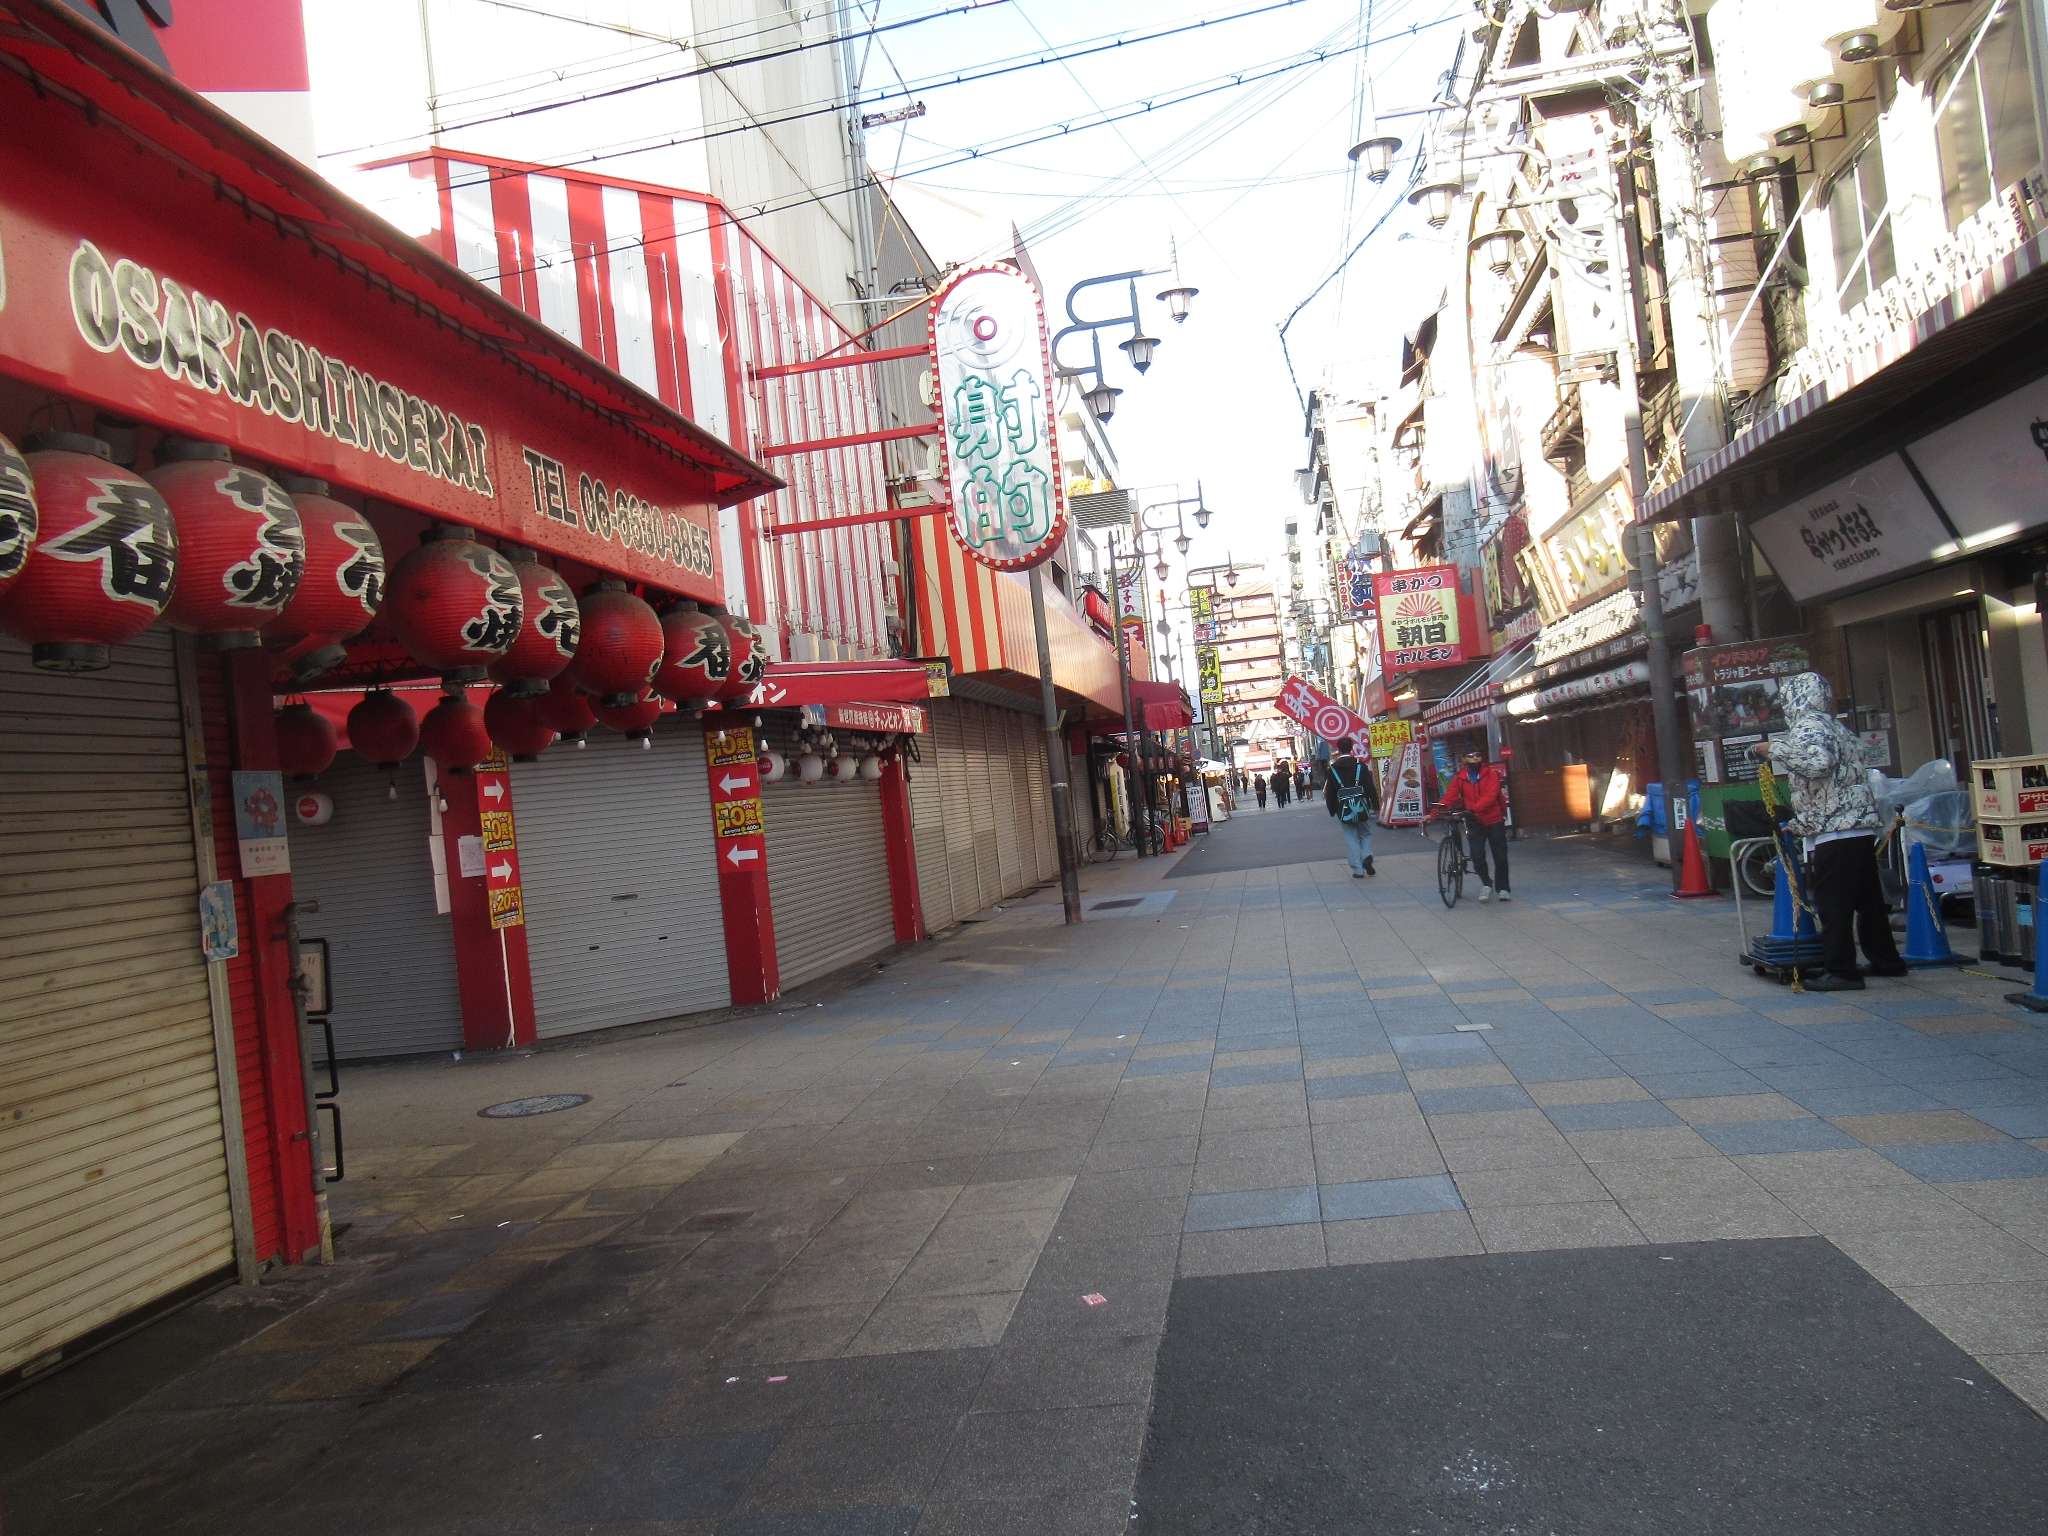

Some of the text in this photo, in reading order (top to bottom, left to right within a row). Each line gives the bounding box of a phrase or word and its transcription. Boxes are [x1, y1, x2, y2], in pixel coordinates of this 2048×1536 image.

[69, 239, 494, 497] OSAKASHINSEKAI
[952, 367, 1048, 549] 射的
[523, 446, 579, 529] TEL
[1391, 574, 1443, 593] 串かつ
[1395, 647, 1453, 666] ホルモン
[1396, 621, 1447, 647] 朝日
